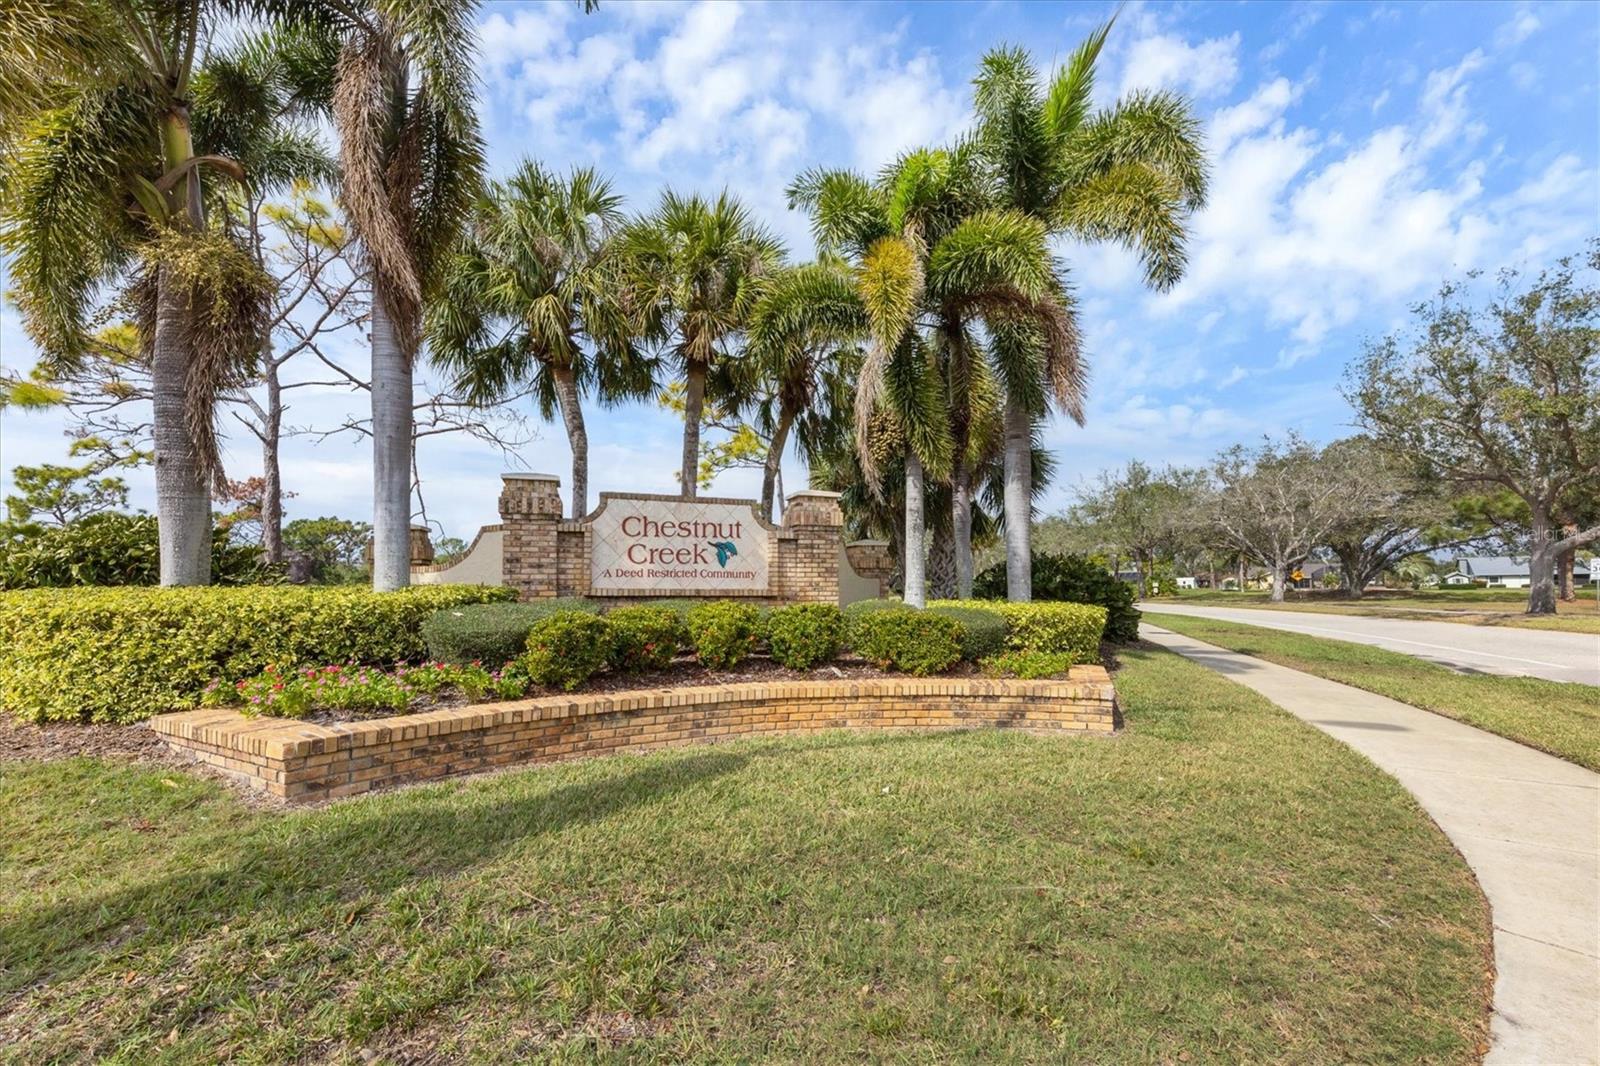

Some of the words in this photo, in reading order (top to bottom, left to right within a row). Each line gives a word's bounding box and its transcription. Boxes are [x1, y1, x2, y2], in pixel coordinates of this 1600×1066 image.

[622, 516, 742, 539] Chestnut
[627, 543, 708, 565] Creek
[604, 569, 612, 578] A
[616, 569, 643, 578] Deed
[647, 569, 697, 578] Restricted
[700, 569, 757, 580] Community
